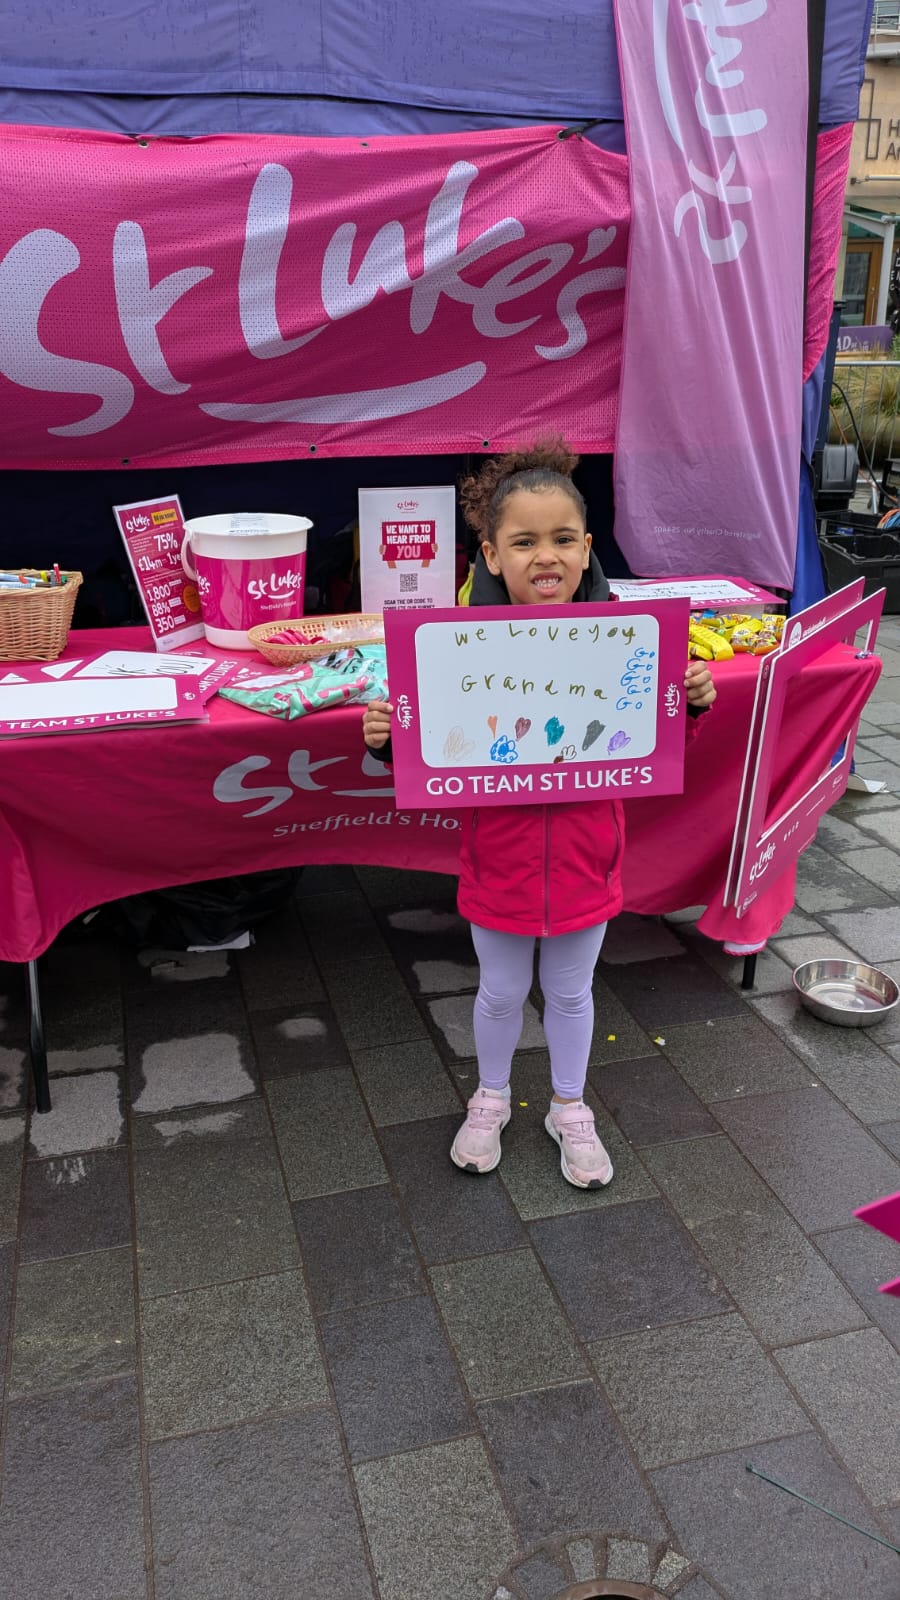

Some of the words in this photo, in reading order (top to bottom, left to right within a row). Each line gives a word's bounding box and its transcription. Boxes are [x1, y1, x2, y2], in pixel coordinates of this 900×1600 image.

[0, 220, 213, 437] St
[238, 160, 625, 361] Luke's
[386, 524, 397, 534] WE
[398, 524, 419, 534] WANT
[420, 524, 431, 533] TO
[153, 532, 178, 552] 75%
[387, 534, 408, 545] HEAR
[409, 534, 431, 544] FROM
[397, 545, 421, 559] YOU
[146, 584, 171, 604] 1,800
[247, 578, 269, 600] St
[270, 569, 302, 592] Luke's
[152, 601, 171, 617] 88%
[155, 614, 175, 634] 350
[626, 658, 653, 671] Go
[461, 673, 608, 700] Grandma
[620, 670, 651, 686] Go
[626, 684, 652, 695] Go
[664, 683, 677, 706] Luke's
[616, 696, 643, 711] Go
[7, 719, 67, 729] TEAM
[74, 717, 99, 725] ST
[105, 710, 176, 721] LUKE'S
[401, 705, 413, 730] Luke's
[213, 749, 348, 818] St
[426, 777, 464, 795] GO
[467, 774, 533, 794] TEAM
[539, 772, 567, 790] ST
[574, 766, 653, 789] LUKE'S
[272, 811, 411, 838] Sheffield's
